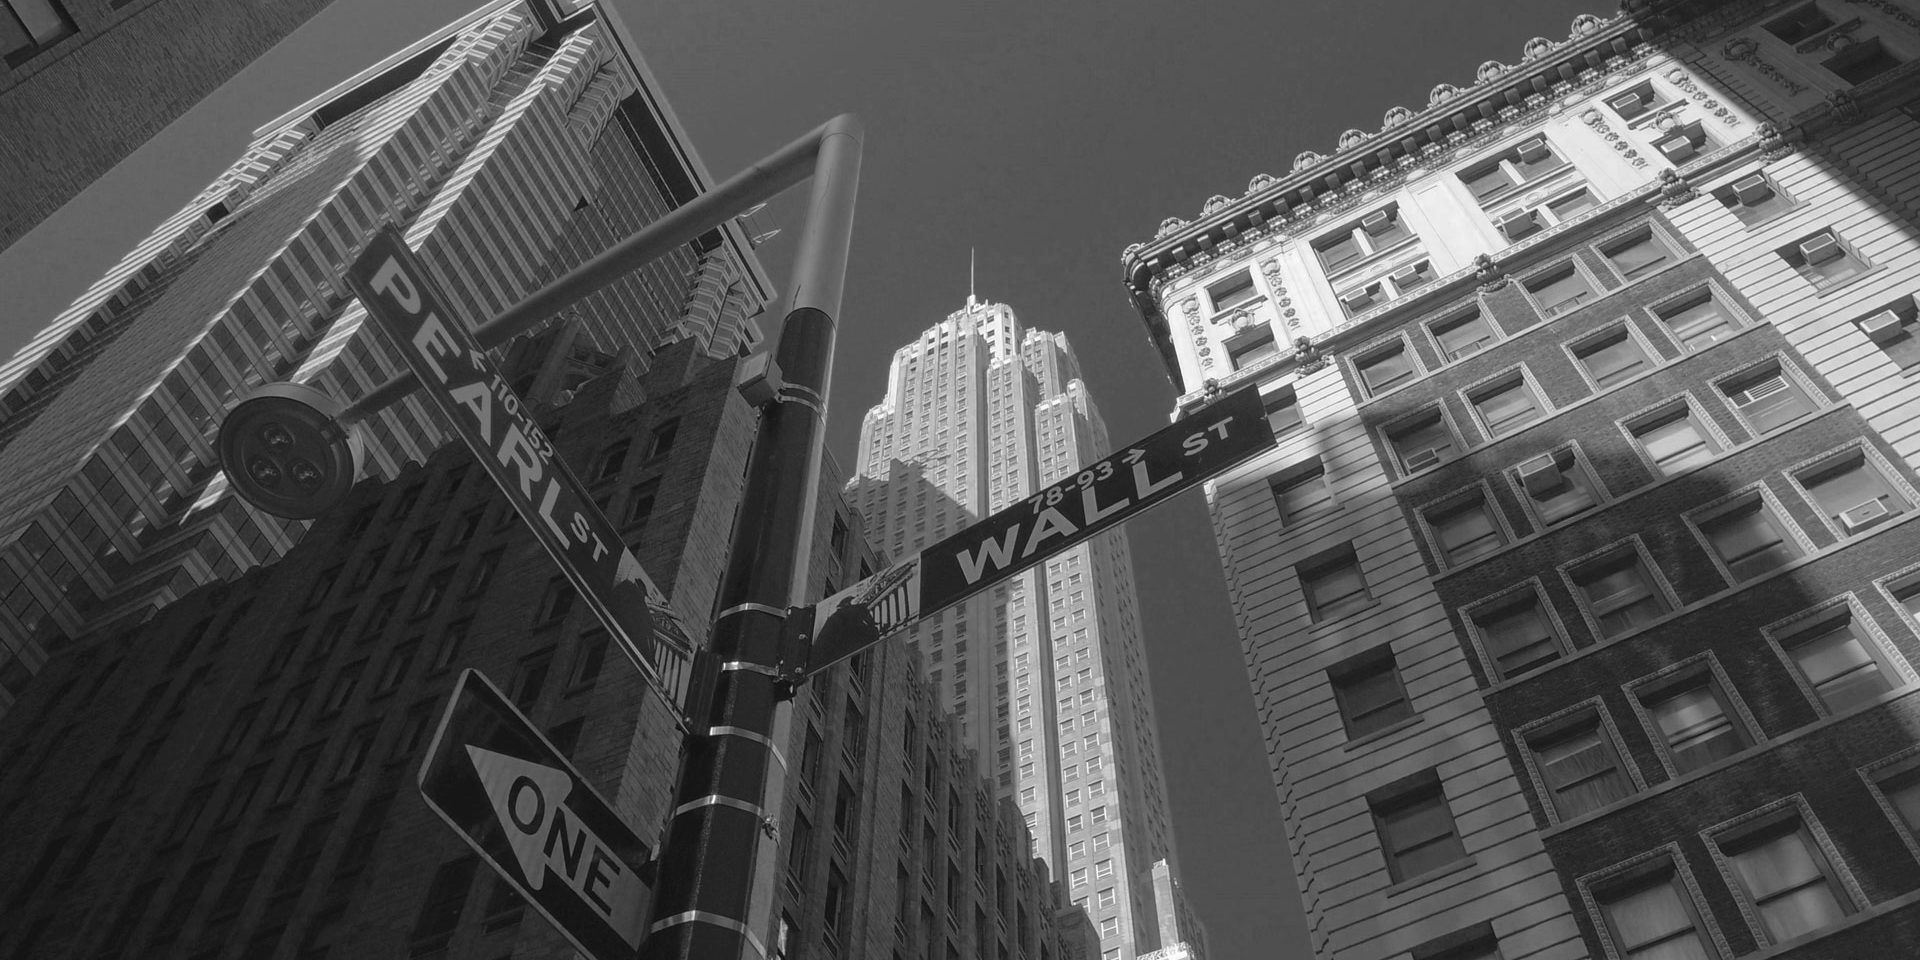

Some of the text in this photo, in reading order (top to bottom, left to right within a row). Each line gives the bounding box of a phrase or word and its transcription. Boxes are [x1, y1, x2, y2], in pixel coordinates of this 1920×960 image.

[370, 256, 609, 562] PEARL ST
[492, 376, 553, 465] 110-152
[957, 416, 1233, 585] WALL ST
[1029, 462, 1114, 514] 78-93
[508, 775, 621, 917] ONE
